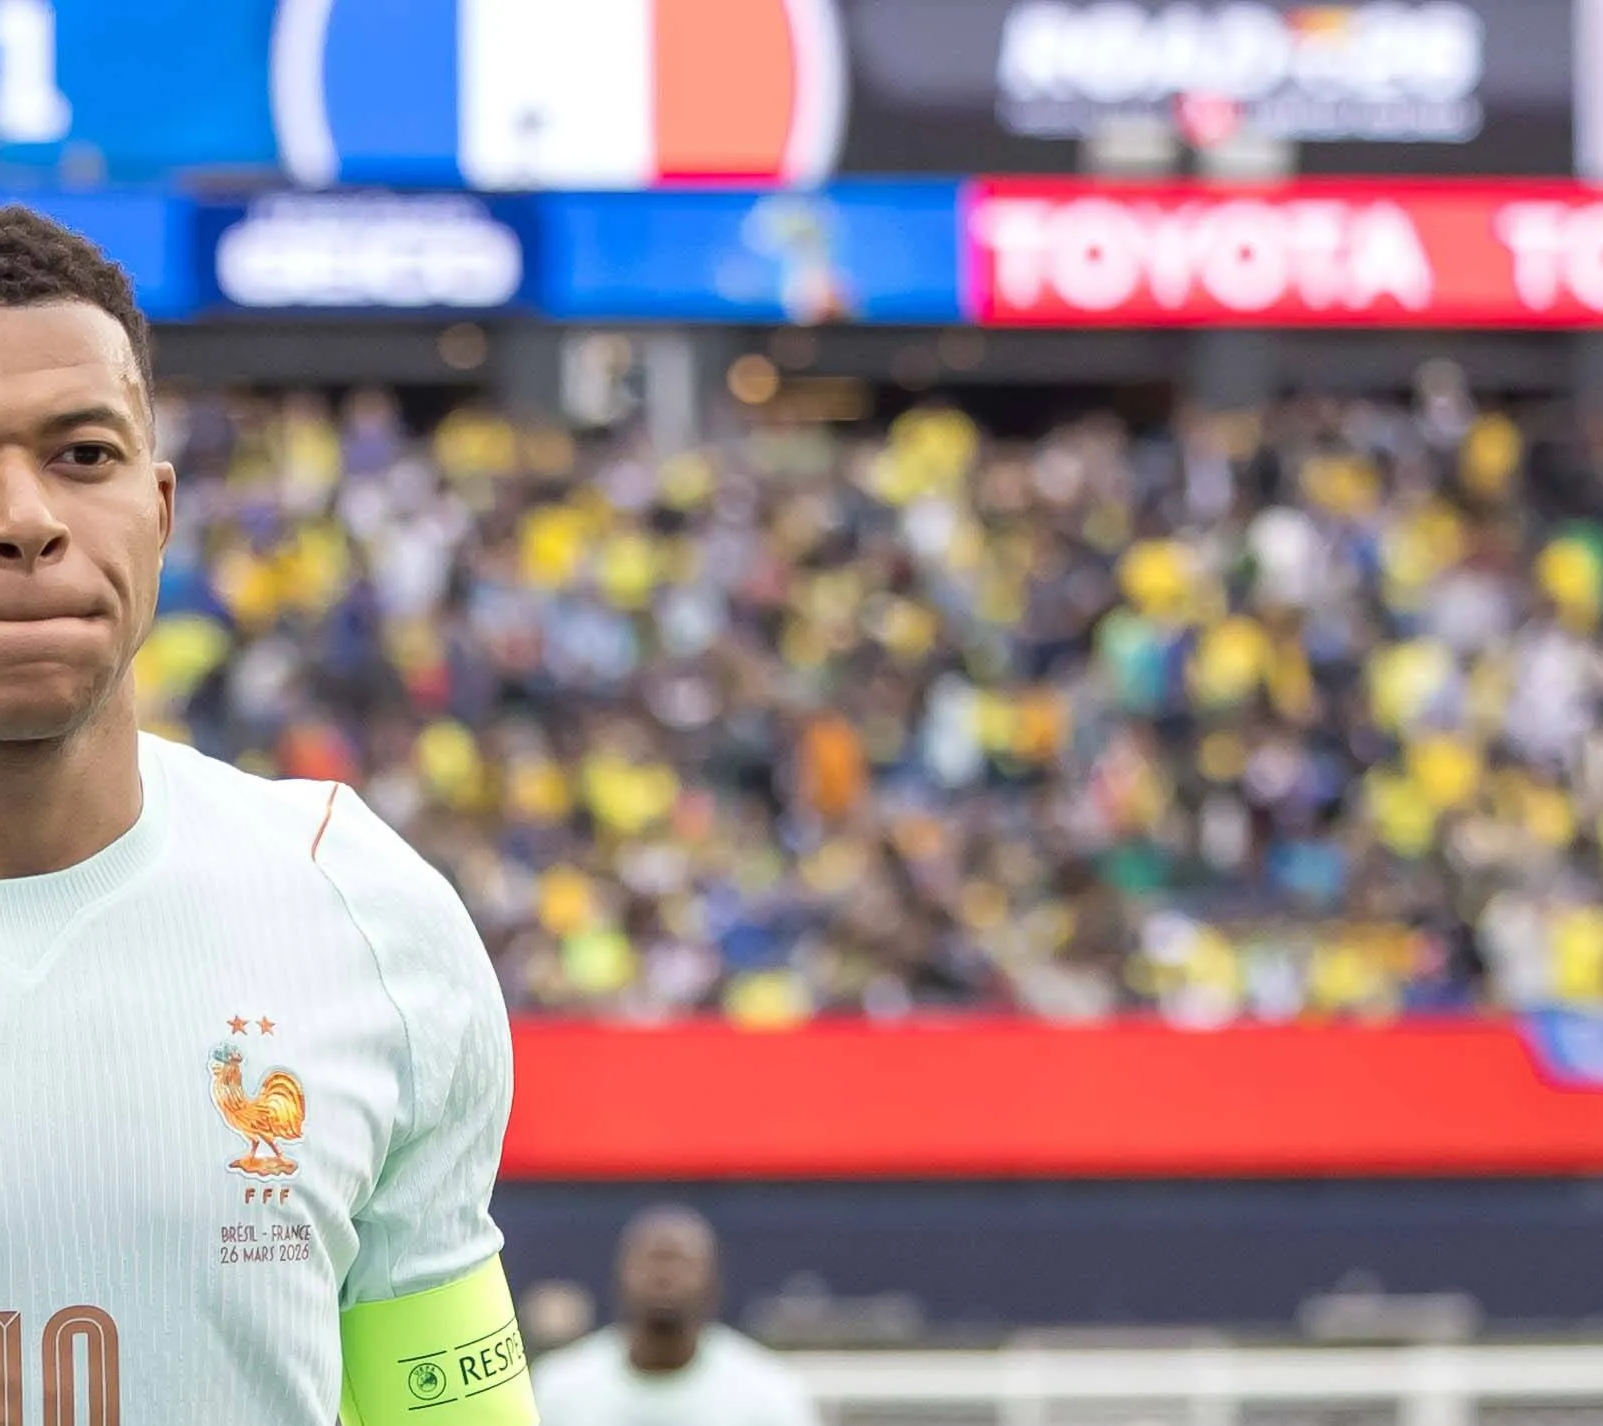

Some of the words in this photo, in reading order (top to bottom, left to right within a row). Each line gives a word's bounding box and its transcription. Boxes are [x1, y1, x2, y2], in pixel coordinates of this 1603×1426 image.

[971, 199, 1434, 312] TOYOTA
[220, 1221, 257, 1243] BRÉSIL
[271, 1223, 311, 1242] FRANCE
[220, 1246, 239, 1265] 26
[243, 1244, 274, 1262] MARS
[279, 1242, 310, 1262] 2026
